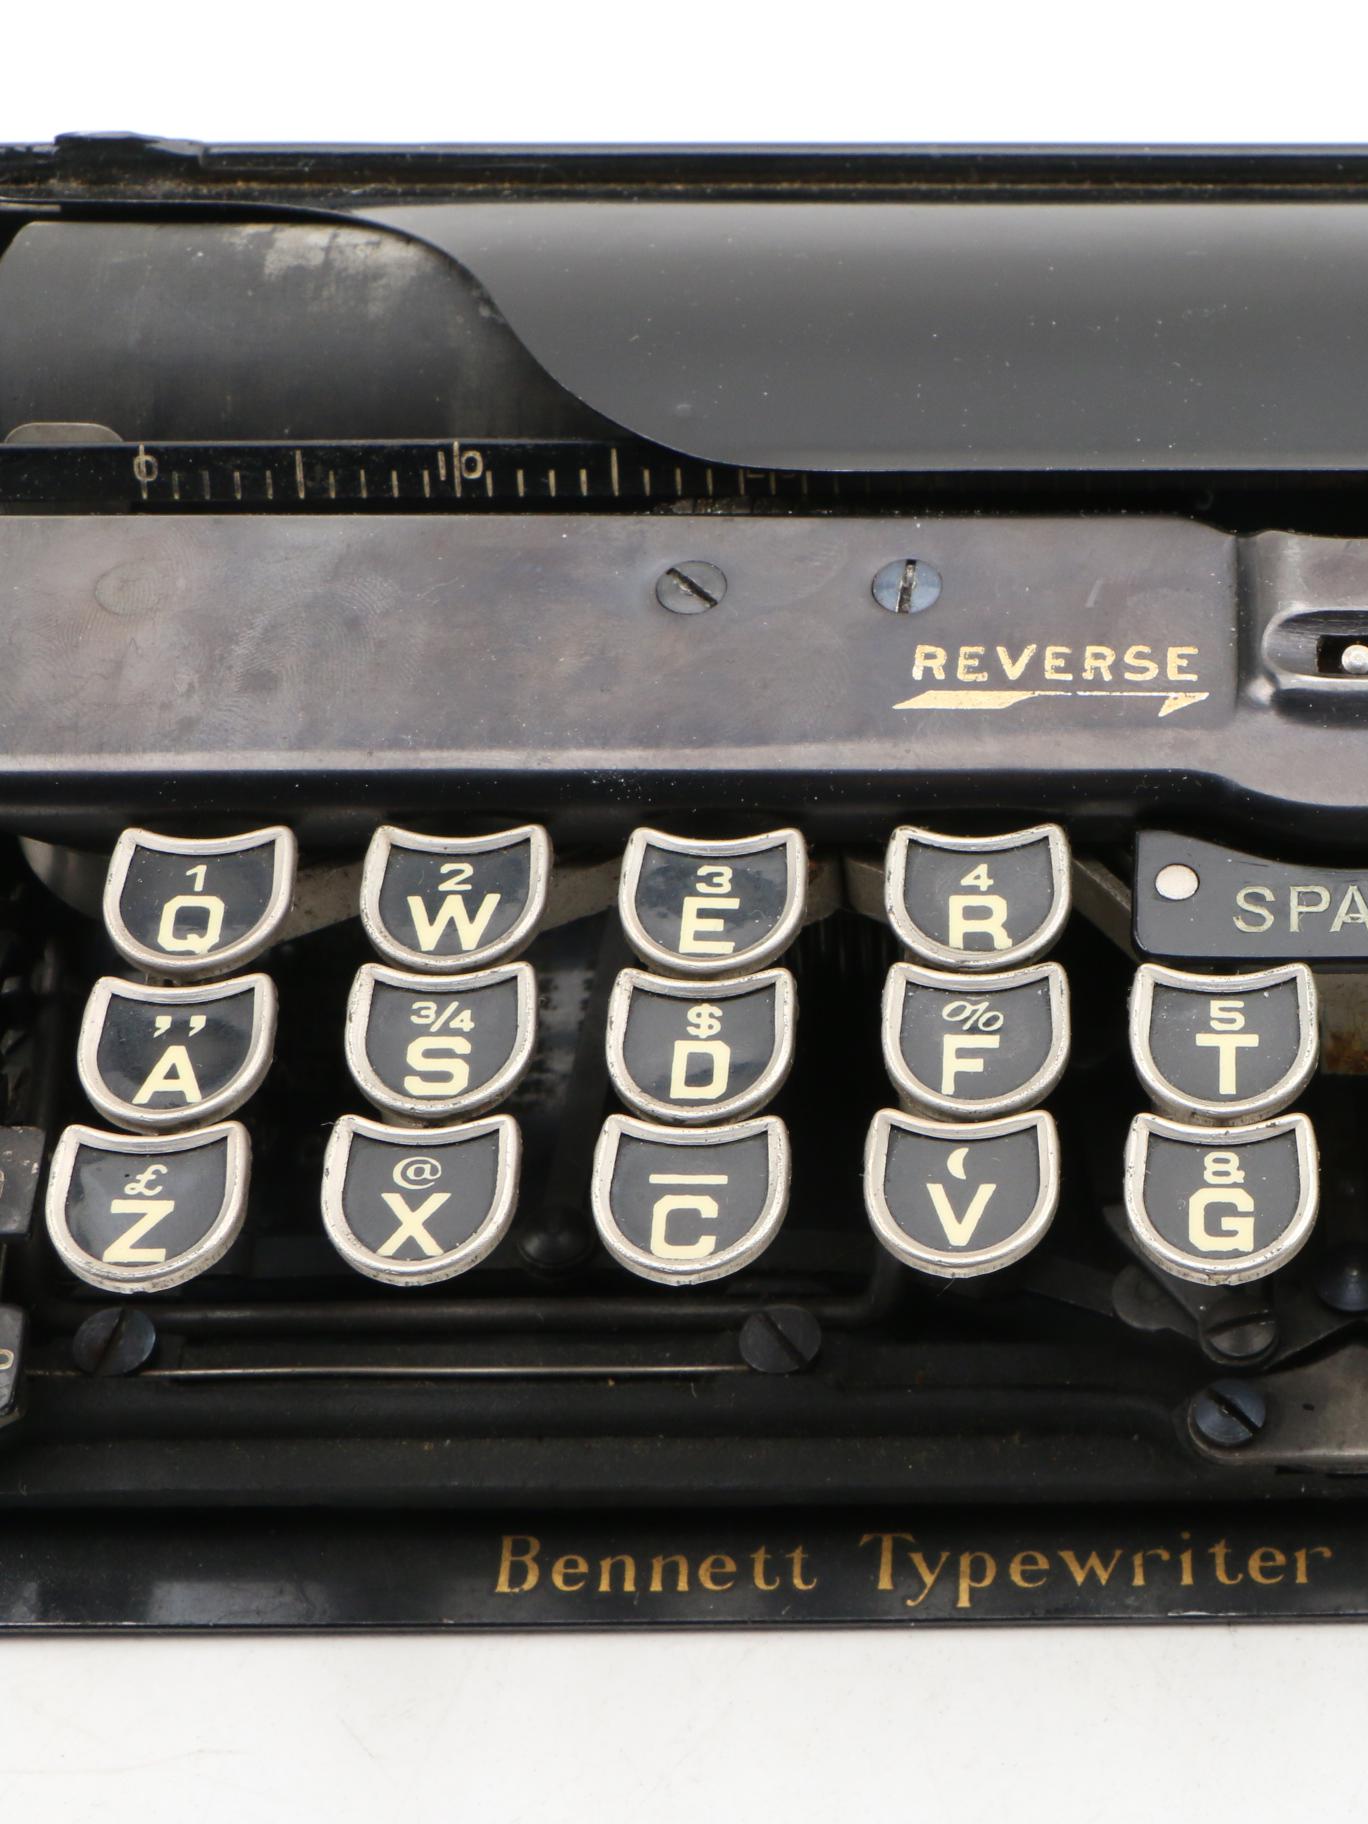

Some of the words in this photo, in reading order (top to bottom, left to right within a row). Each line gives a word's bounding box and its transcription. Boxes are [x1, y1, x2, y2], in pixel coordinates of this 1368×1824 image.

[911, 643, 1199, 682] REVERSE
[185, 864, 208, 892] 1
[437, 862, 474, 892] 2
[695, 865, 733, 895] 3
[960, 863, 994, 892] 4
[157, 895, 224, 951] Q
[407, 893, 500, 950] W
[680, 896, 739, 952] E
[949, 894, 1012, 949] R
[686, 1003, 723, 1039] $
[941, 1000, 1004, 1031] %
[1209, 1000, 1245, 1031] 5
[134, 1045, 200, 1104] A
[405, 1035, 470, 1094] S
[670, 1039, 728, 1097] D
[943, 1034, 999, 1092] F
[1197, 1033, 1259, 1092] T
[124, 1164, 168, 1197] £
[392, 1156, 442, 1190] @
[1203, 1151, 1246, 1185] &
[104, 1199, 172, 1262] Z
[379, 1192, 448, 1256] X
[652, 1195, 717, 1259] C
[929, 1183, 994, 1243] V
[1190, 1187, 1254, 1250] G
[494, 1534, 817, 1595] Bennett
[860, 1531, 1331, 1608] Typewriter
